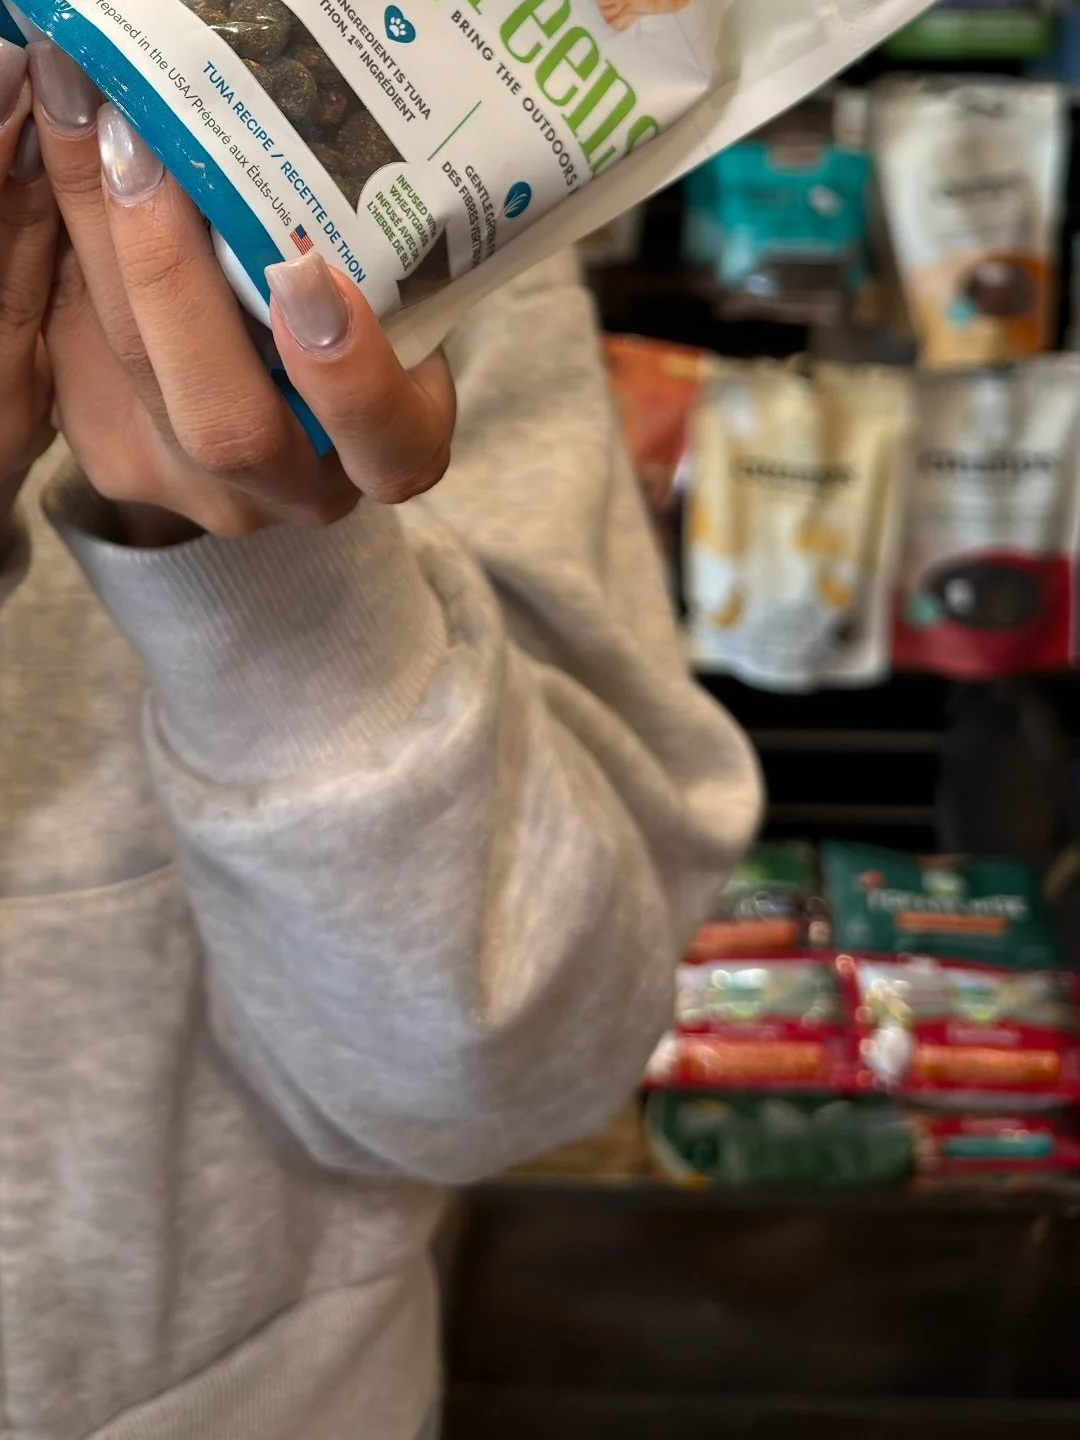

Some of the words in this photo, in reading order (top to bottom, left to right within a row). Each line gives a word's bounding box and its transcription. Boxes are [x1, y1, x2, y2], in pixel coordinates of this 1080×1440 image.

[359, 50, 416, 123] INGRÉDIENT
[393, 68, 407, 85] IS
[404, 80, 432, 121] TUNA
[451, 9, 494, 62] BRING
[495, 62, 522, 96] THE
[522, 97, 579, 188] OUTDOORS
[138, 34, 151, 52] in
[147, 47, 169, 70] the
[167, 69, 233, 145] USA/Préparé
[229, 143, 248, 169] aux
[246, 165, 292, 227] États-Unis
[202, 60, 235, 105] TUNA
[232, 101, 275, 151] RECIPE
[280, 161, 328, 224] RECETTE
[323, 221, 342, 244] DE
[337, 241, 367, 283] THON
[396, 174, 428, 216] INFUSED
[441, 161, 462, 188] DES
[459, 185, 479, 229] FIBRES
[465, 165, 490, 214] GENTLE
[366, 201, 396, 242] L'HERBE
[392, 237, 405, 256] DE
[400, 252, 412, 272] BLÉ
[375, 191, 403, 228] INFUSÉ
[398, 224, 417, 251] AVEC
[389, 184, 429, 248] WHEATGRASS
